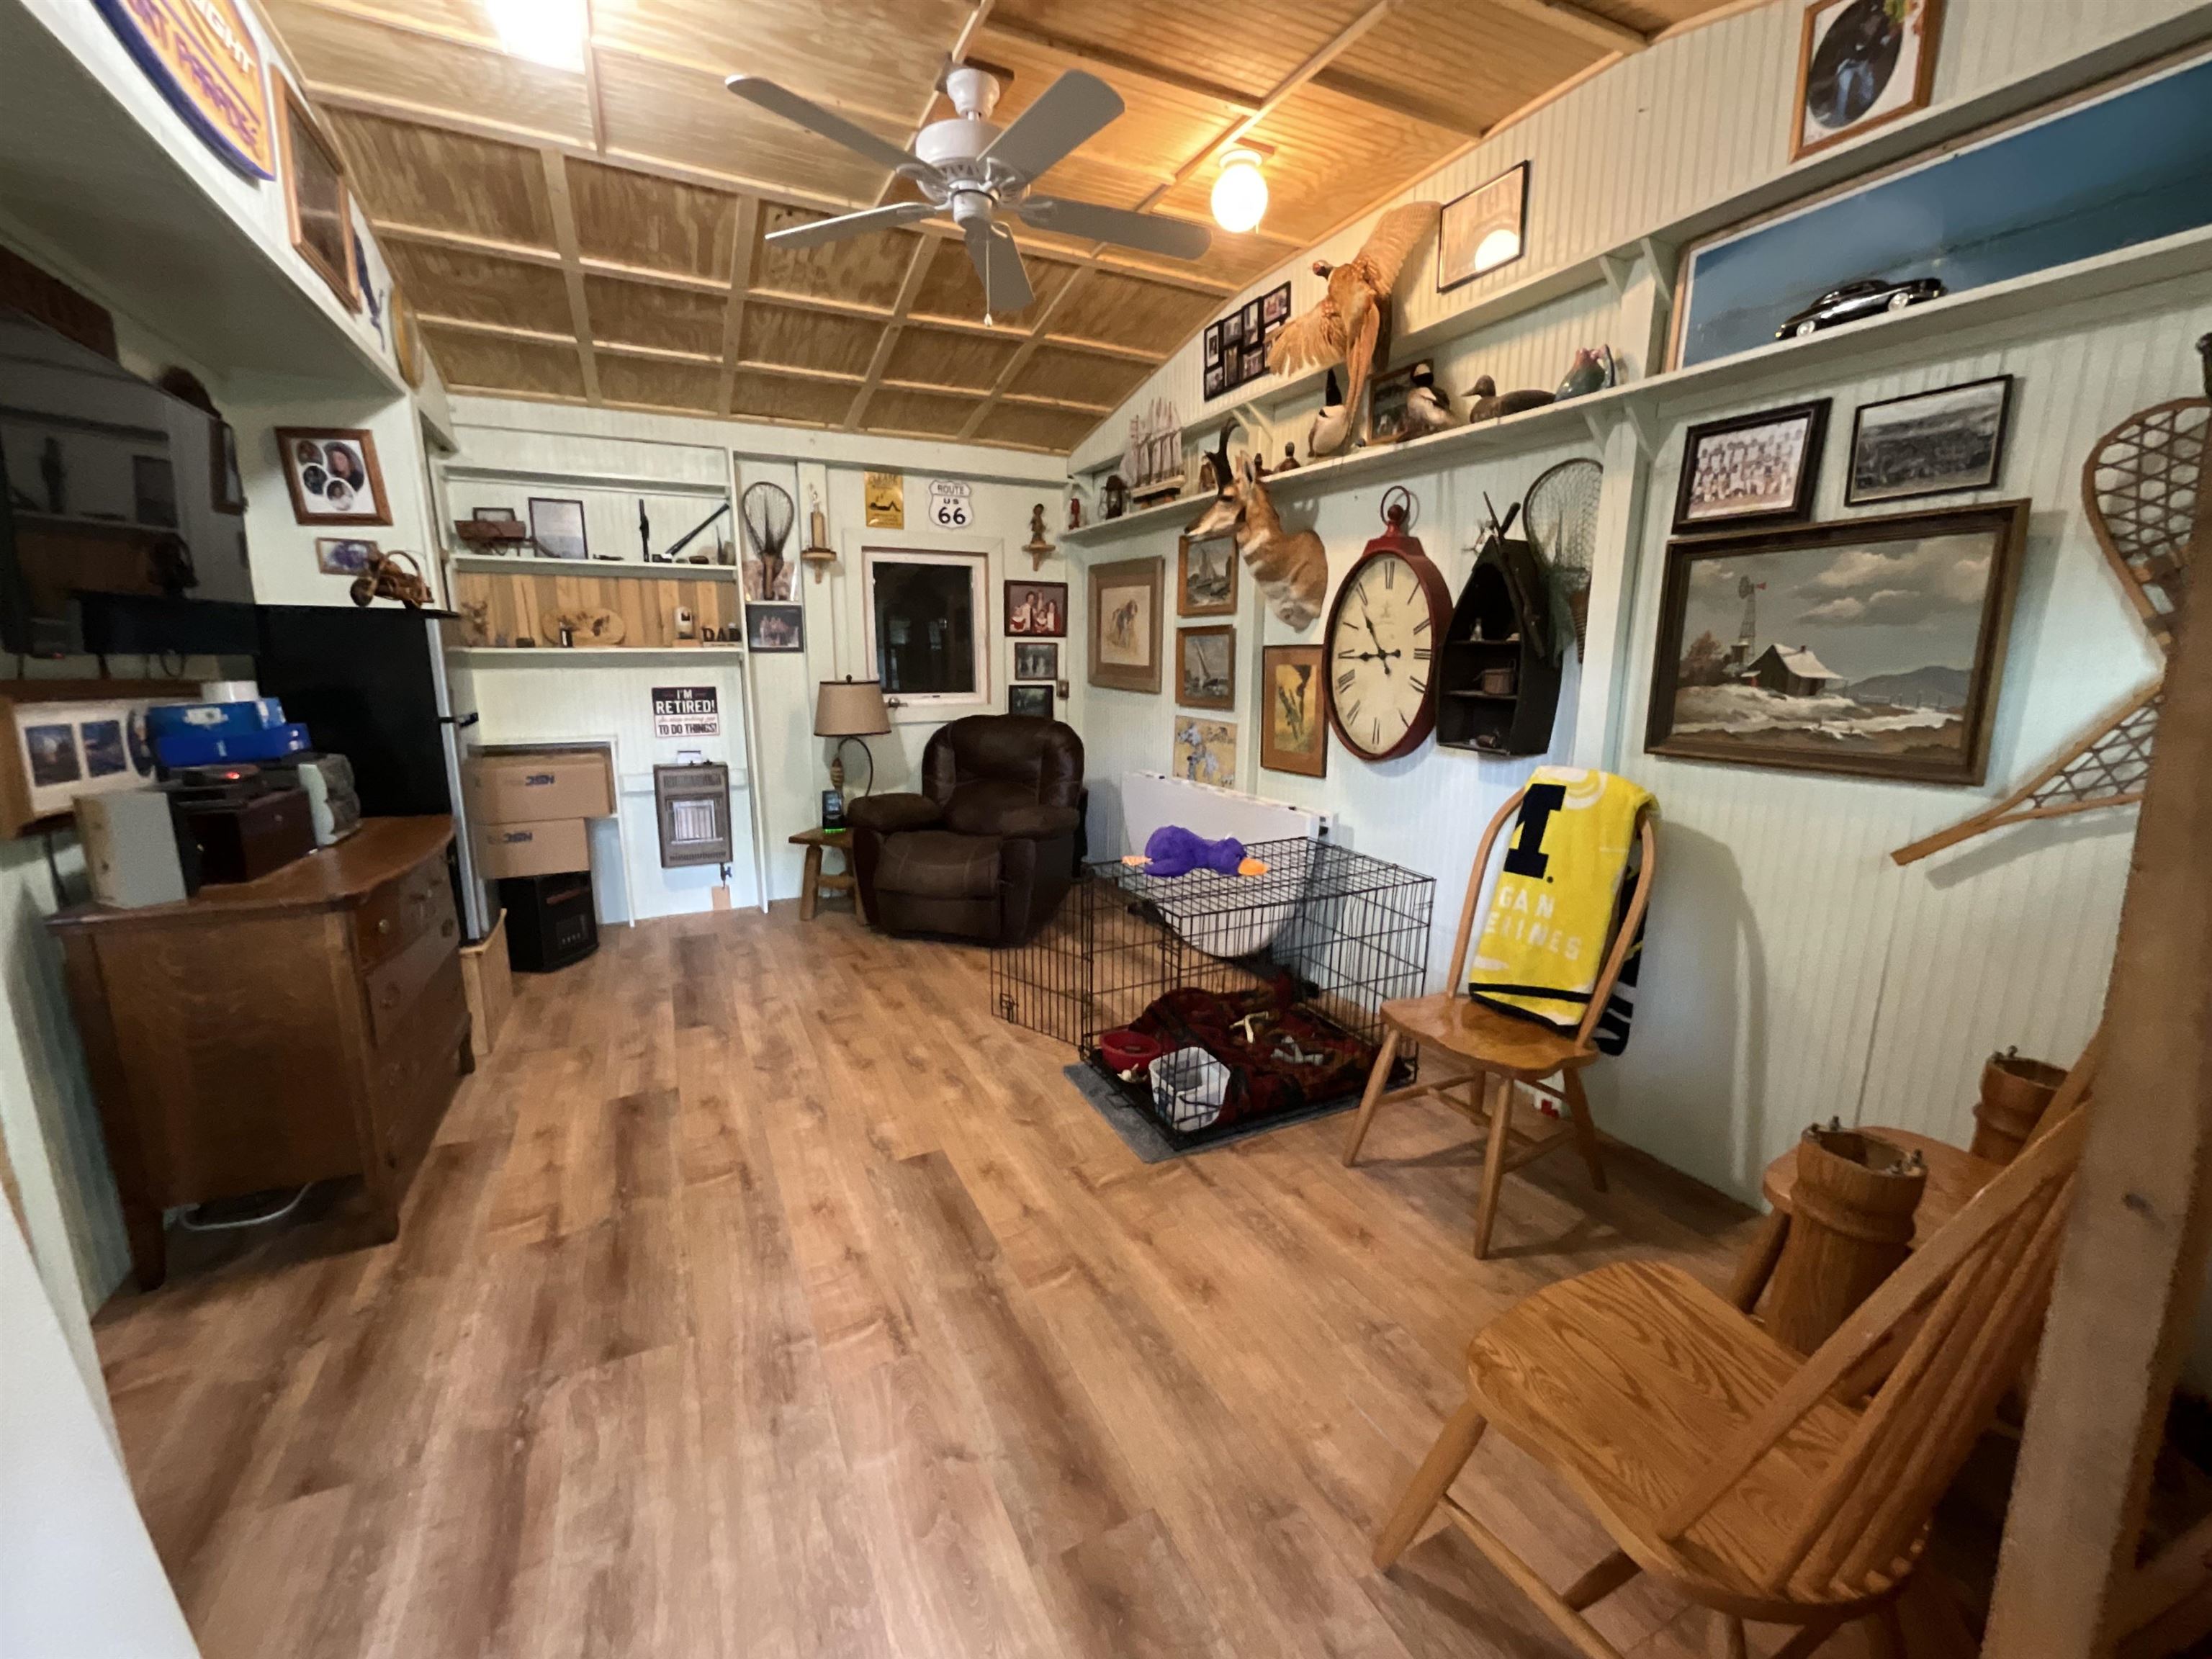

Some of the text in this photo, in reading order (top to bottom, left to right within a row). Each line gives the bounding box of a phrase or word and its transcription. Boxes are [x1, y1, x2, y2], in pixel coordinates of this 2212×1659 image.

[938, 485, 965, 495] ROUTE
[938, 506, 966, 525] 66
[701, 627, 741, 642] DAD
[677, 689, 693, 699] I'M
[656, 700, 716, 714] RETIRED!
[658, 723, 717, 735] TO DO THINGS!
